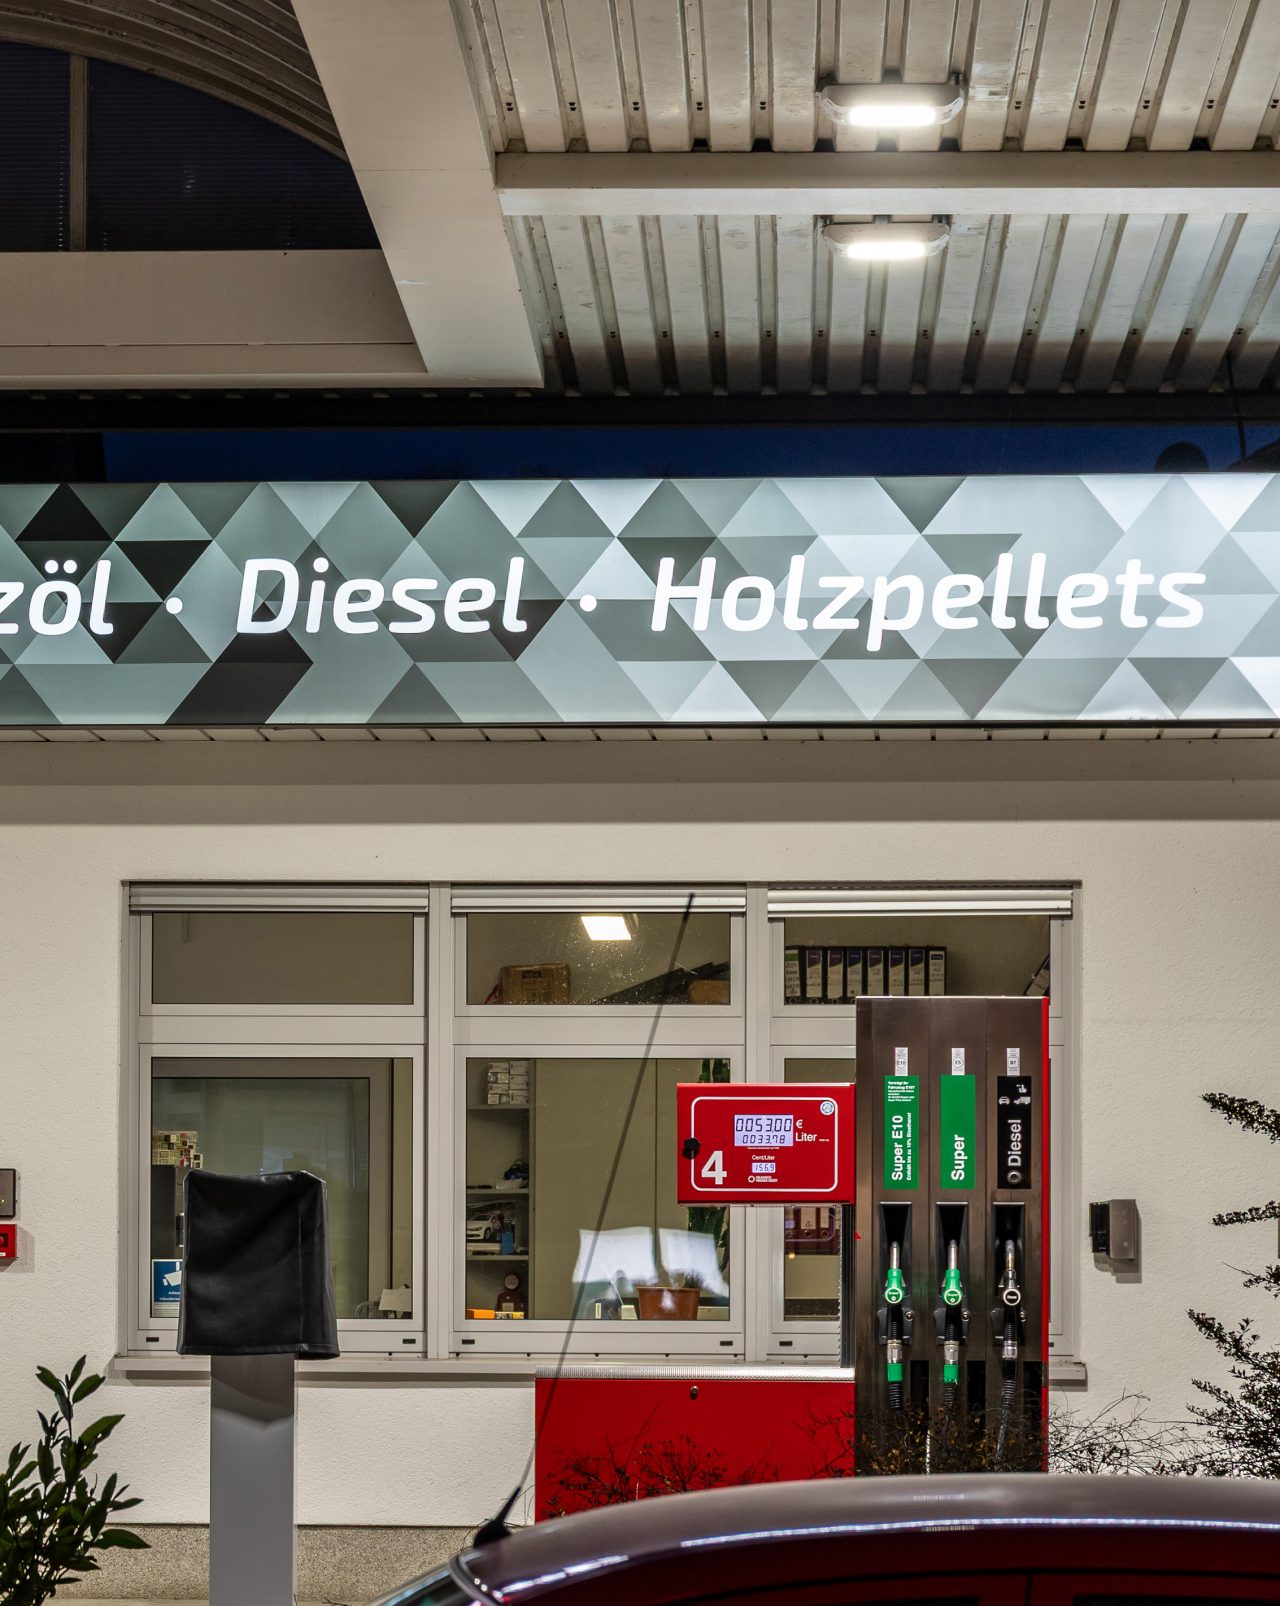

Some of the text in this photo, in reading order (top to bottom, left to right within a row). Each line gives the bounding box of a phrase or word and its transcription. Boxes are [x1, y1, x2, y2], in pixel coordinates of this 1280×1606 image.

[235, 556, 528, 635] Diesel
[650, 552, 1207, 653] Holzpellets
[795, 1119, 804, 1129] €
[795, 1132, 818, 1142] Liter
[1008, 1119, 1021, 1167] Diesel
[701, 1150, 727, 1185] 4
[892, 1115, 905, 1180] Super E10
[951, 1135, 968, 1180] Super
